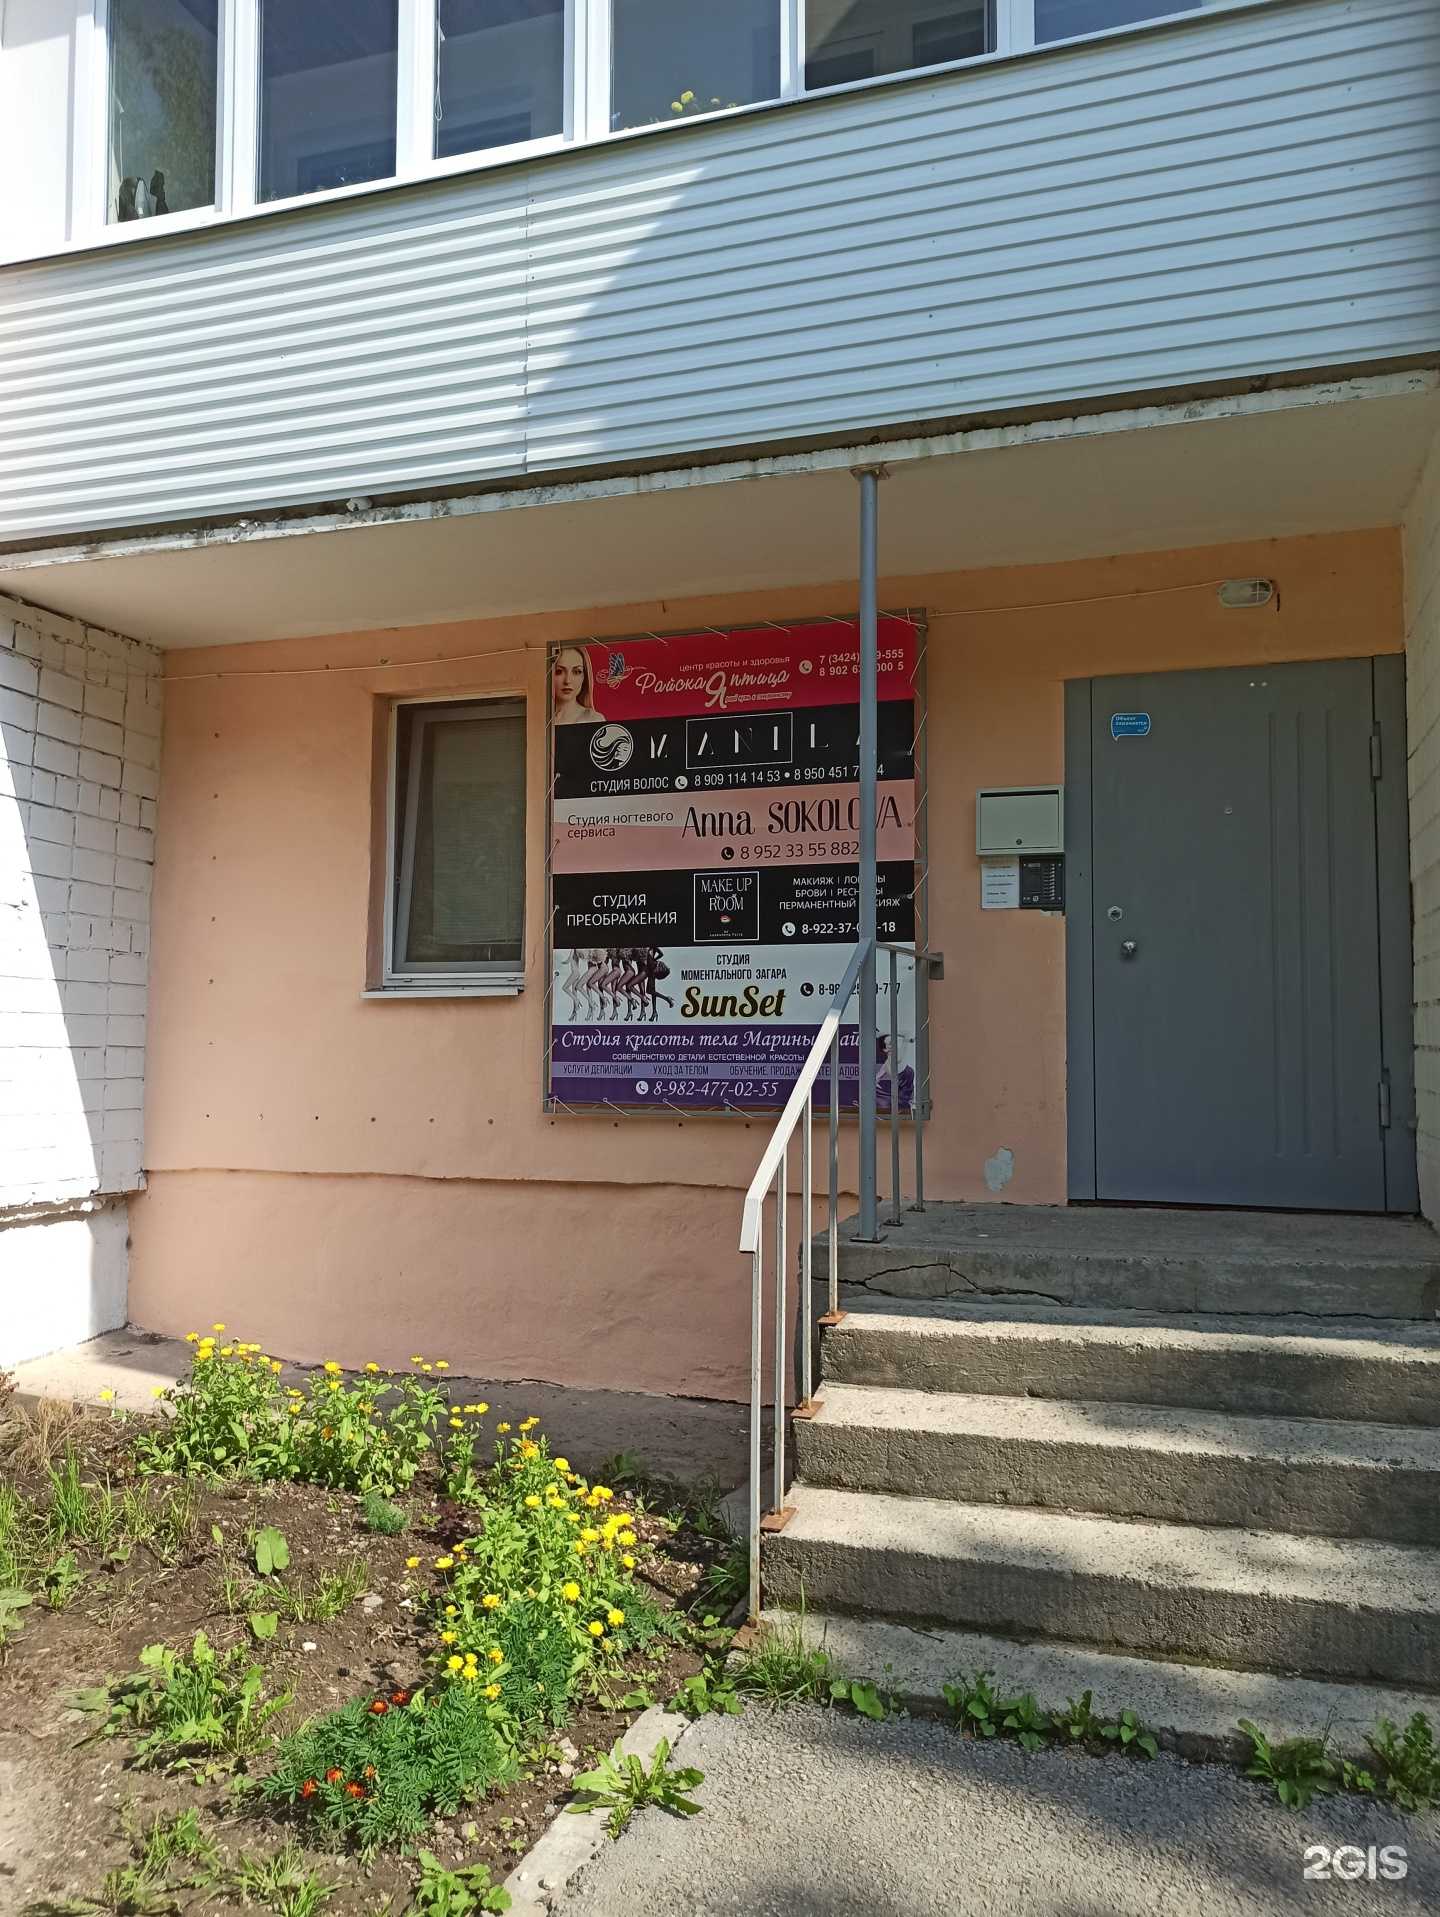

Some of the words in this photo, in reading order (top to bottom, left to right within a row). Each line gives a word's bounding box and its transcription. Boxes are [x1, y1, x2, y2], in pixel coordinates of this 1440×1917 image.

[679, 663, 704, 673] центр
[705, 660, 740, 671] красоты
[750, 656, 790, 666] здоровья
[819, 655, 826, 665] 7
[828, 652, 860, 666] (3424)
[819, 667, 826, 677] 8
[829, 666, 848, 676] 902
[897, 661, 904, 671] 5
[590, 778, 631, 794] СТУДИЯ
[633, 776, 669, 790] ВОЛОС
[694, 774, 701, 787] 8
[704, 773, 724, 786] 909
[728, 772, 747, 784] 114
[751, 771, 763, 783] 14
[766, 770, 781, 782] 53
[794, 768, 801, 781] 8
[804, 767, 825, 780] 950
[828, 766, 848, 778] 451
[567, 814, 610, 828] Студия
[613, 812, 674, 825] ногтевого
[682, 806, 755, 839] Anna
[567, 826, 616, 840] сервиса
[740, 846, 750, 860] 8
[754, 844, 781, 859] 952
[786, 843, 804, 858] 33
[808, 842, 827, 857] 55
[830, 841, 860, 856] 882
[700, 878, 734, 893] MAKE
[736, 877, 752, 892] UP
[792, 877, 834, 886] МАКИЯЖ
[592, 893, 647, 909] СТУДИЯ
[795, 888, 827, 898] БРОВИ
[709, 895, 744, 911] ROOM
[779, 898, 856, 910] ПЕРМАНЕНТНЫЙ
[567, 911, 678, 927] ПРЕОБРАЖЕНИЯ
[716, 953, 750, 966] СТУДИЯ
[681, 968, 752, 981] МОМЕНТАЛЬНОГО
[755, 968, 787, 980] ЗАГАРА
[680, 985, 786, 1018] SunSet
[561, 1029, 621, 1051] Студия
[626, 1033, 694, 1051] красоты
[700, 1033, 738, 1047] тела
[742, 1030, 815, 1052] Марины
[612, 1053, 676, 1061] СОВЕРШЕНСТВУЮ
[678, 1053, 706, 1061] ДЕТАЛИ
[708, 1052, 767, 1061] ЕСТЕСТВЕННОЙ
[769, 1053, 805, 1061] КРАСОТЫ
[563, 1064, 590, 1075] УСЛУГИ
[590, 1064, 633, 1076] ДЕПИЛЯЦИИ
[653, 1065, 672, 1076] УХОД
[673, 1065, 683, 1075] ЗА
[684, 1065, 709, 1075] ТЕЛОМ
[653, 1080, 779, 1097] 8-982-477-02-55
